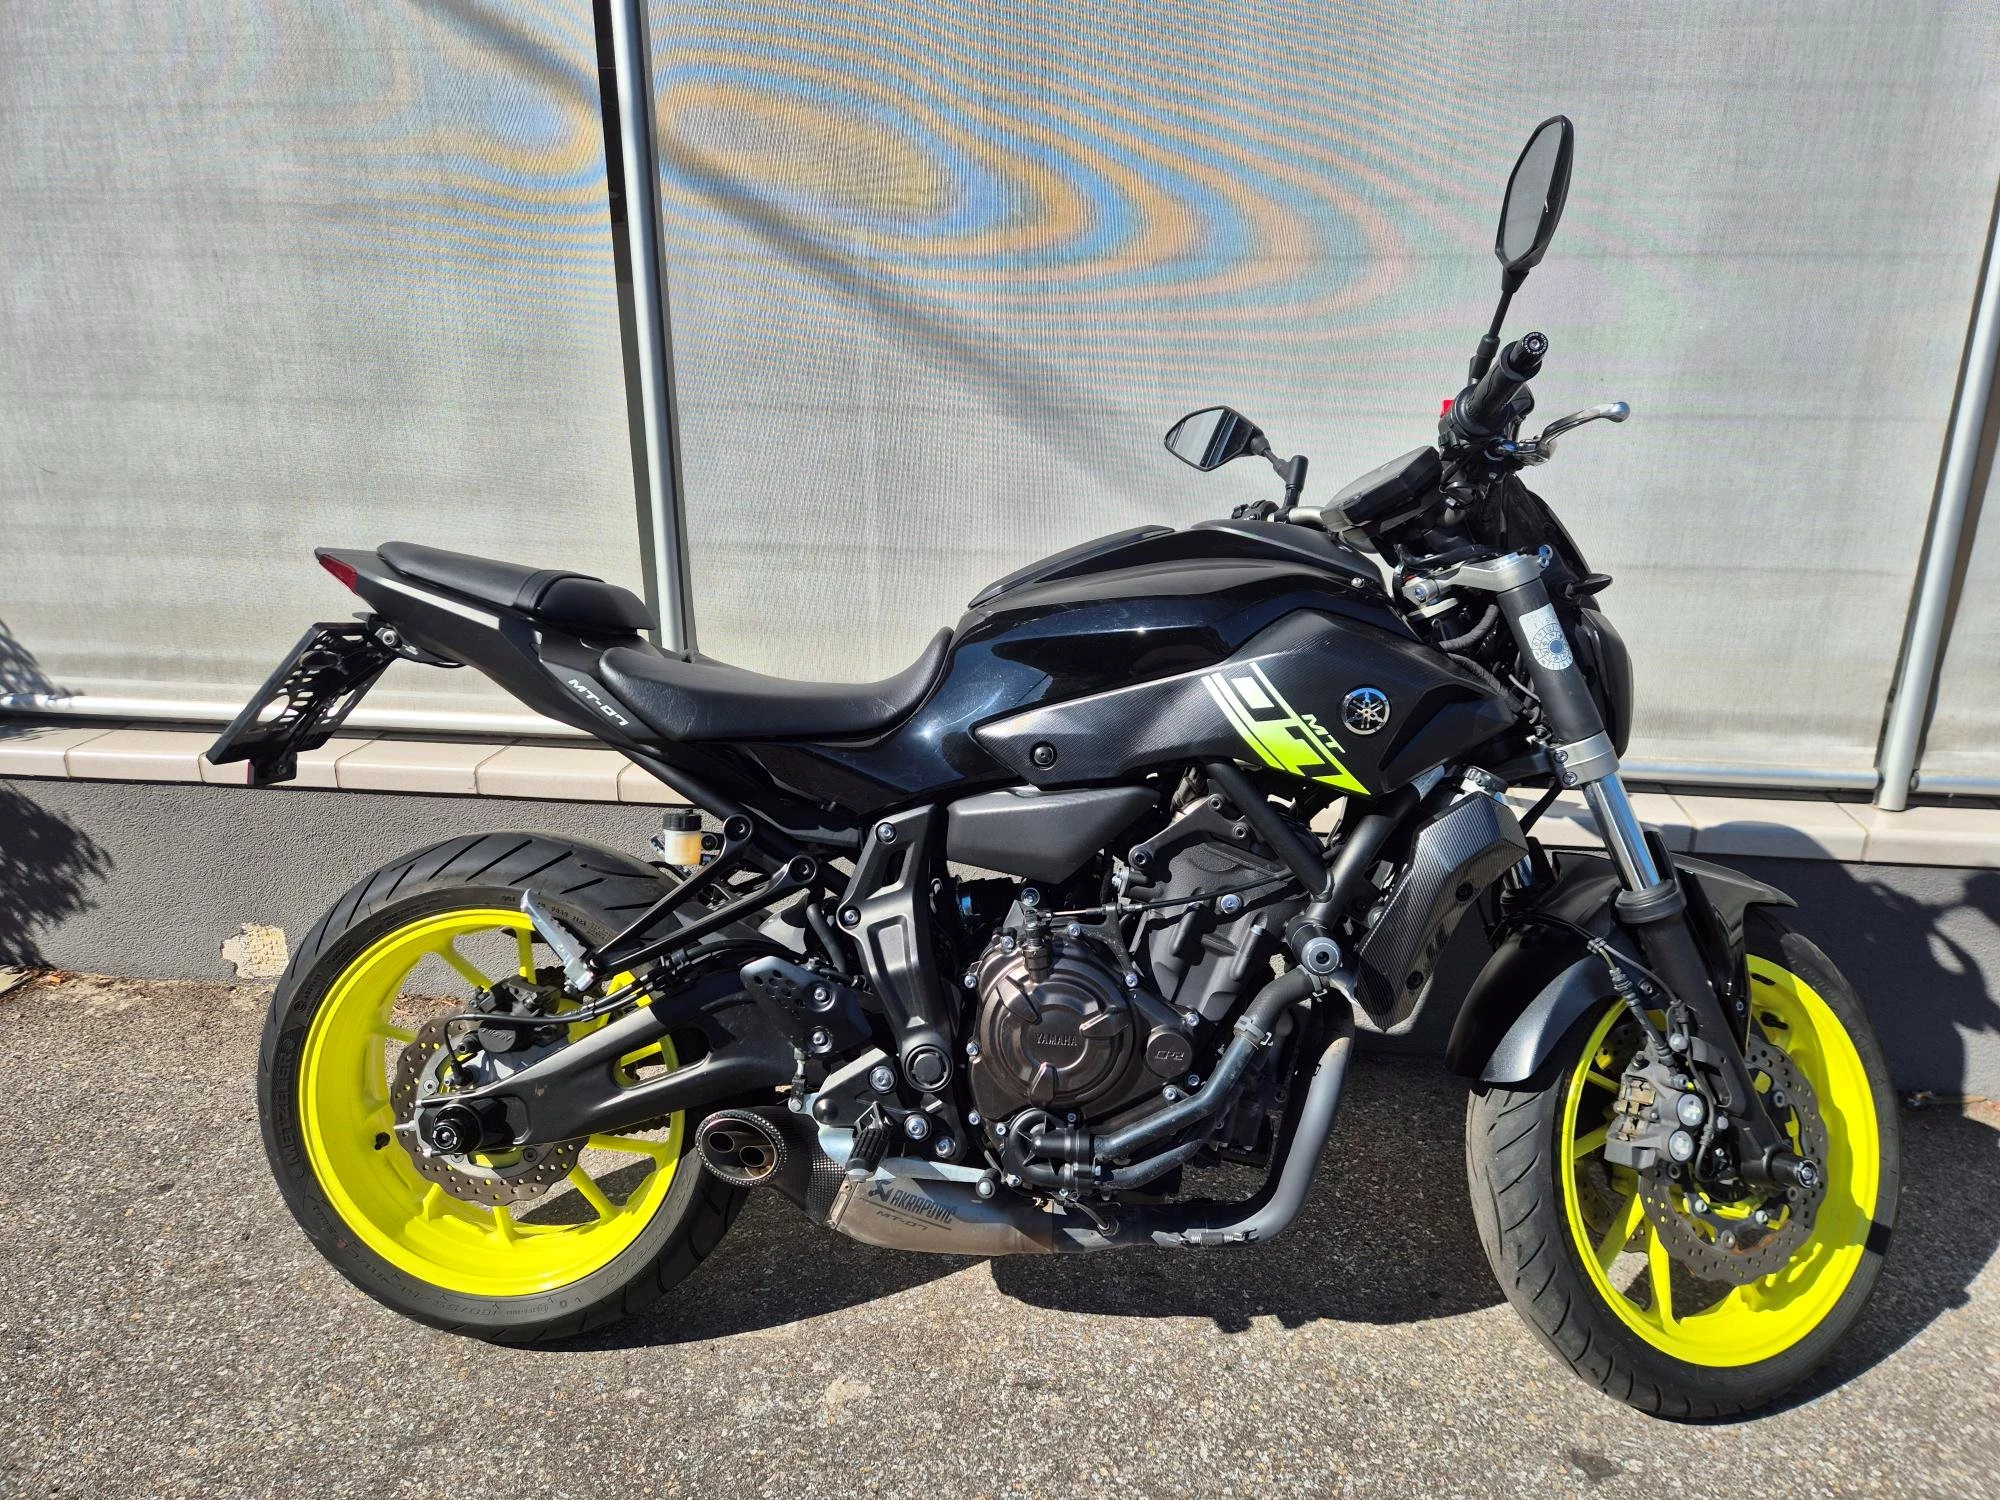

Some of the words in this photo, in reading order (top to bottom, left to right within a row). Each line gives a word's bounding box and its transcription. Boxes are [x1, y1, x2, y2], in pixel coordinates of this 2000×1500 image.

[568, 679, 628, 726] MT-07
[1301, 714, 1346, 754] MT
[1035, 1032, 1078, 1047] YAMAHA
[277, 1054, 301, 1166] METZELER
[876, 1210, 929, 1231] MT-07
